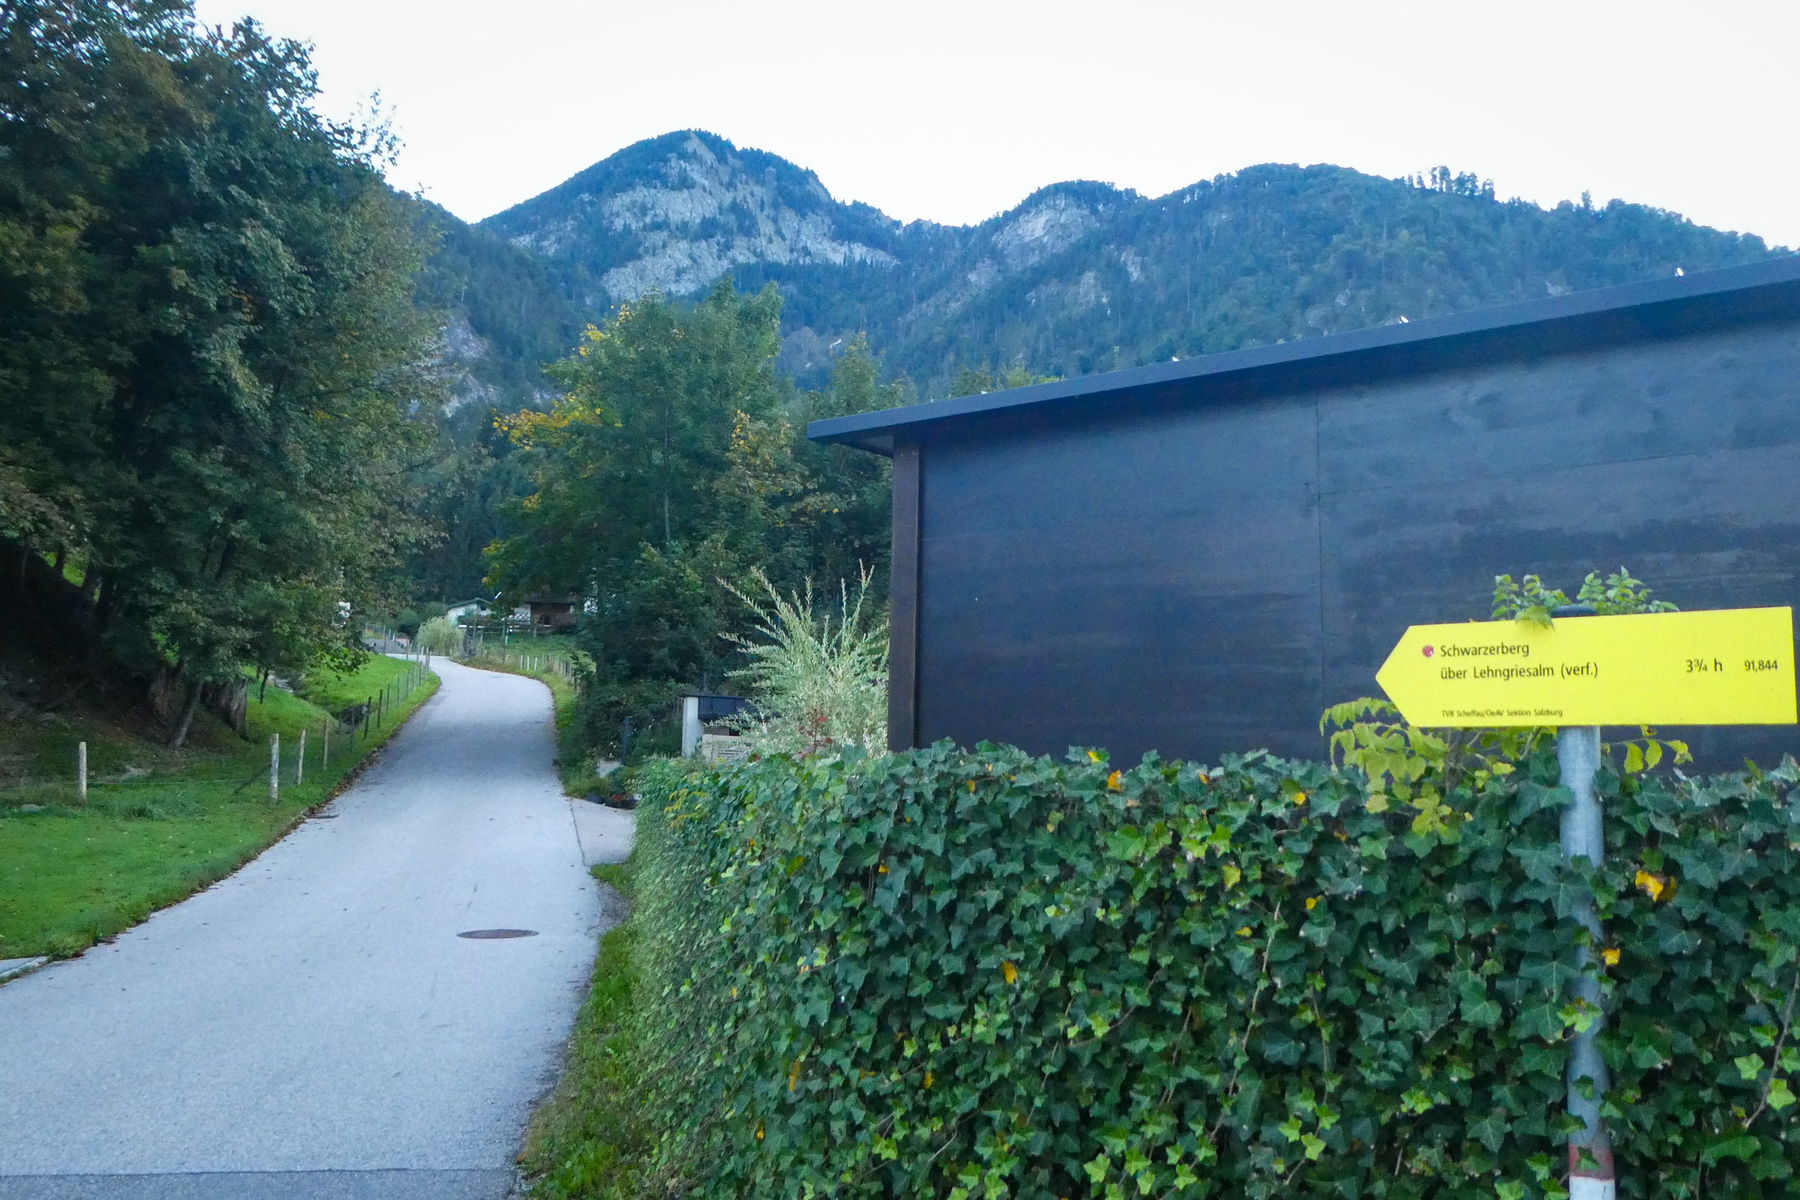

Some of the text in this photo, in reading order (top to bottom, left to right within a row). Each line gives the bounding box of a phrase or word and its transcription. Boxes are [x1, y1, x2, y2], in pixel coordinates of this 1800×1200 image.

[1440, 642, 1529, 657] Schwarzerberg
[1440, 662, 1599, 681] über Lehngriesalm (verf.)
[1714, 658, 1723, 672] h
[1744, 659, 1778, 672] 91,844
[1506, 709, 1531, 717] Sektion
[1534, 708, 1563, 717] Salzburg
